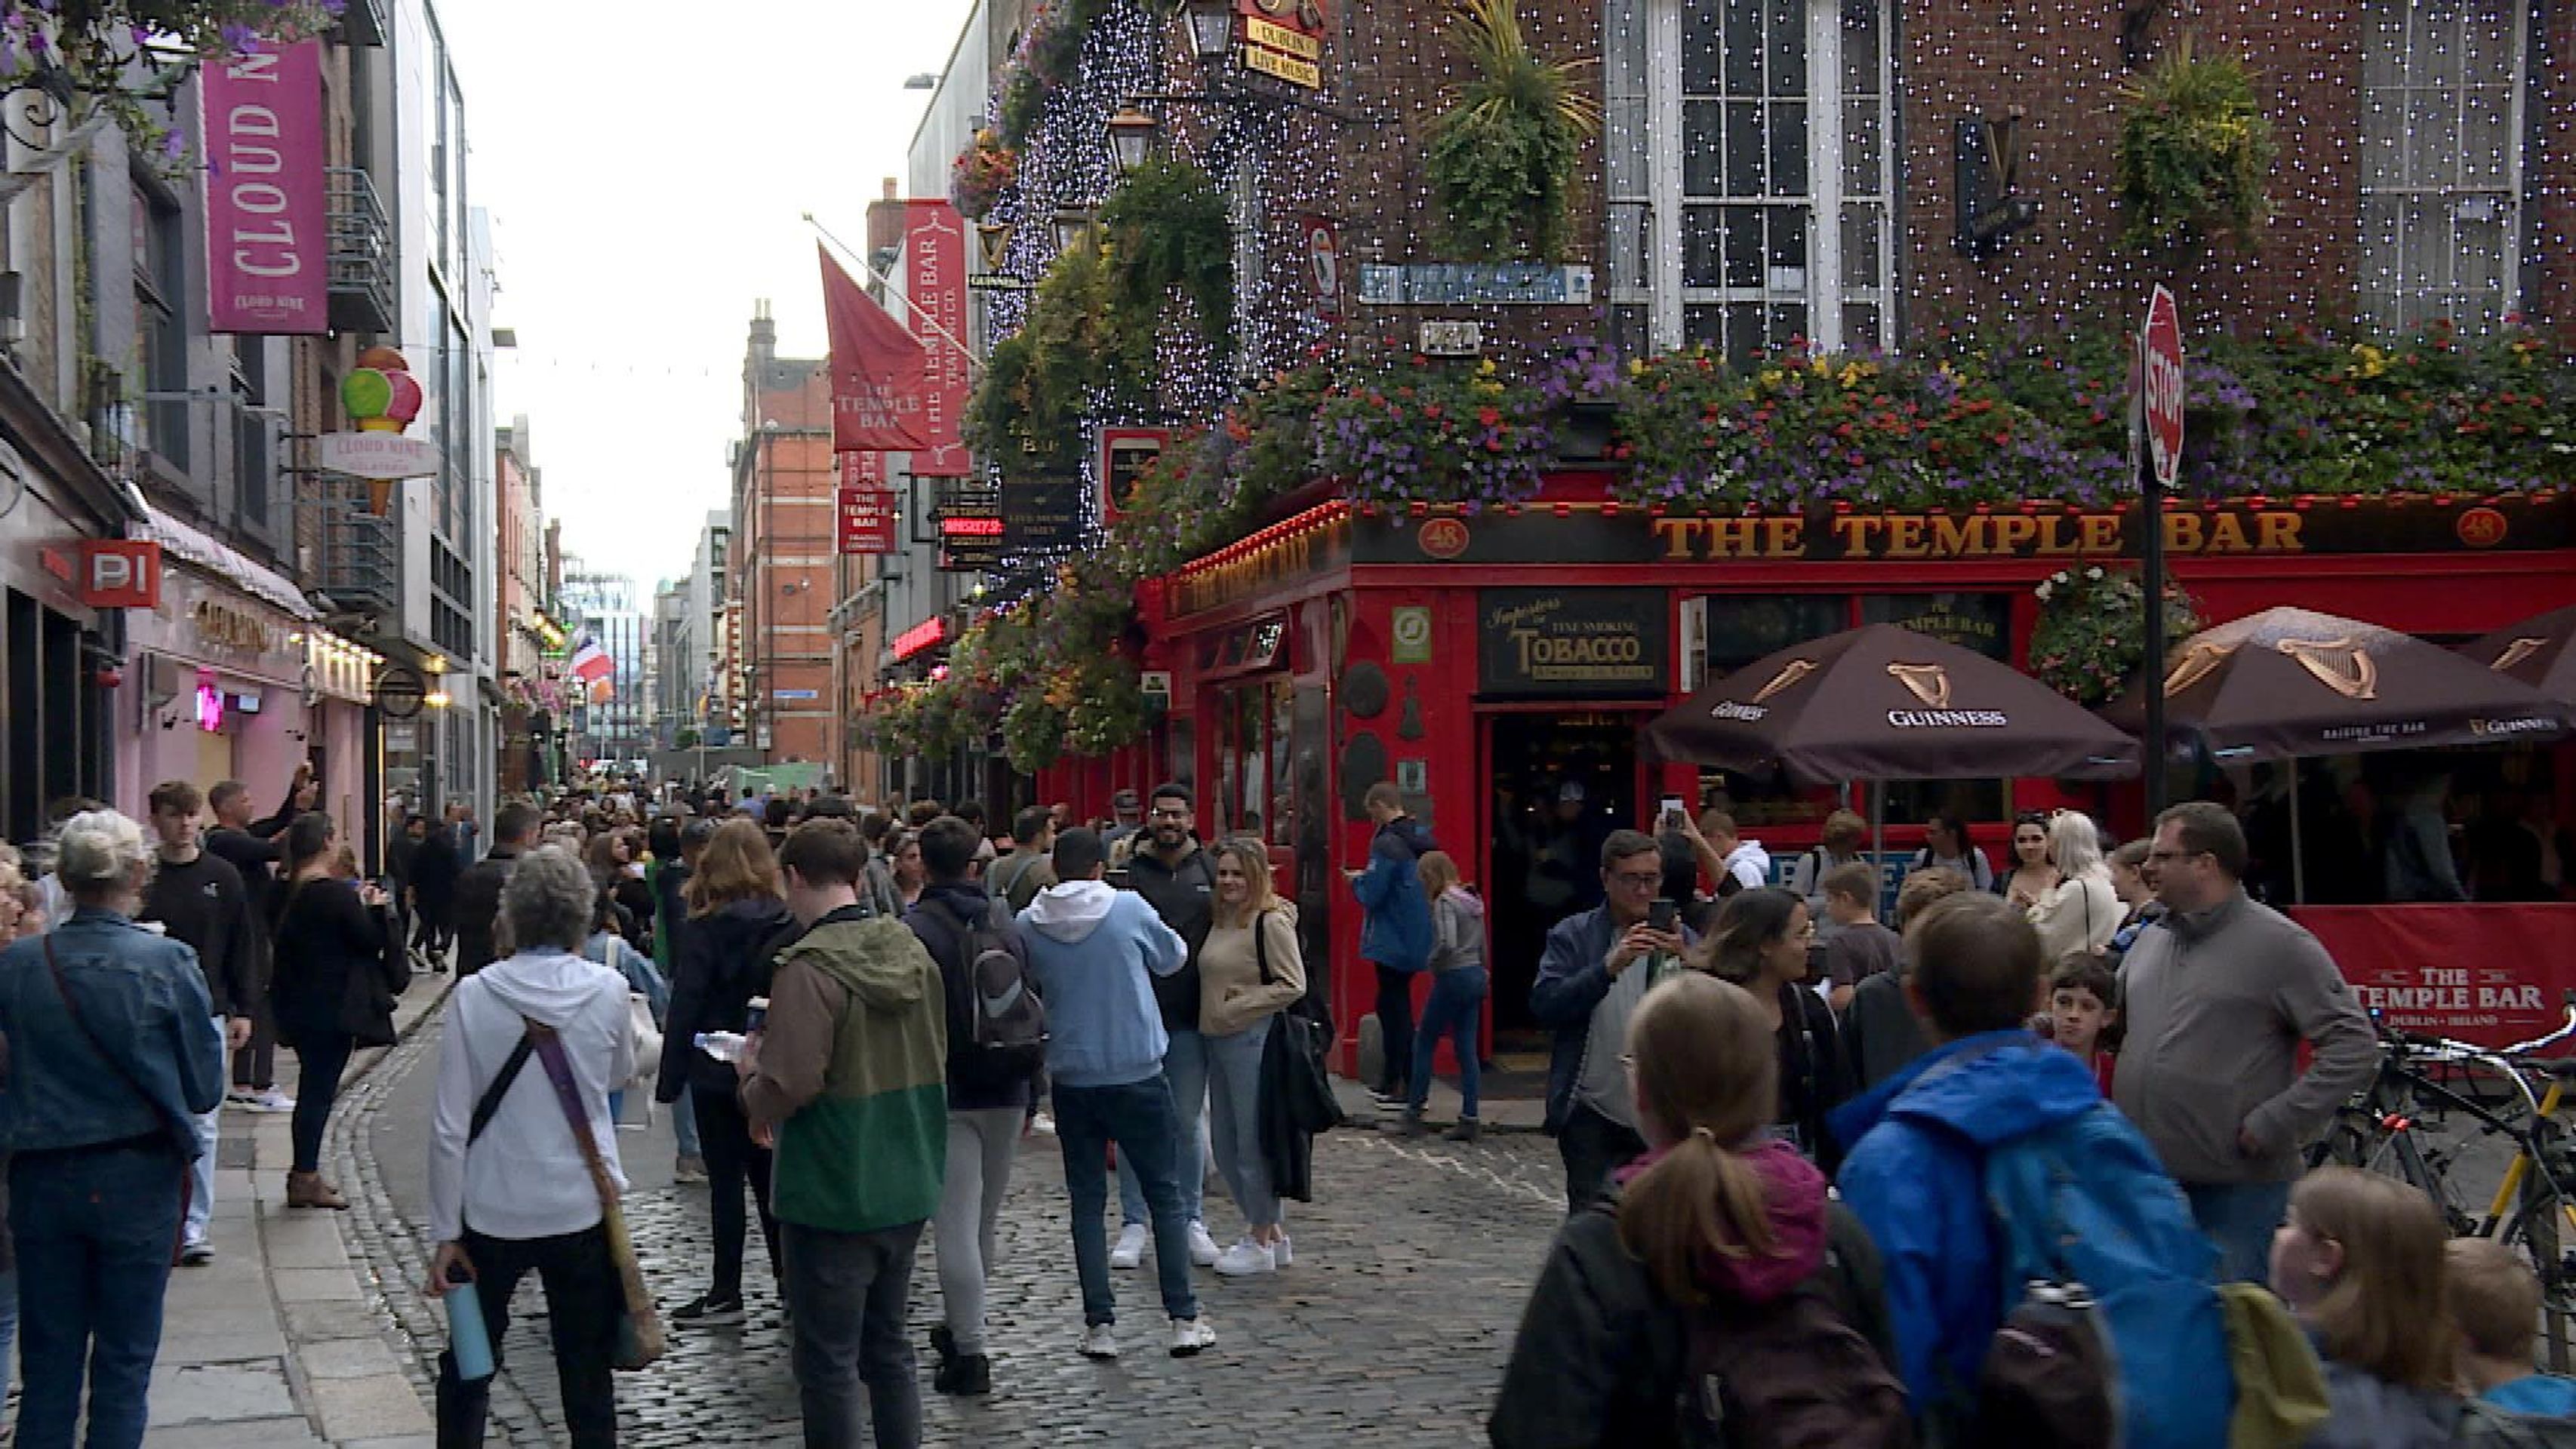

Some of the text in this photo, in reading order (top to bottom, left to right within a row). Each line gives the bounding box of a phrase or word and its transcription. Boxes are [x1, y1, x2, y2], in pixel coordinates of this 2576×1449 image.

[1261, 25, 1305, 53] DUBLIN
[1254, 50, 1315, 82] LIVE MUSIC
[229, 103, 301, 278] CLOUD
[919, 238, 937, 286] BAR
[2150, 346, 2181, 425] STOP
[836, 395, 920, 415] TEMPLE
[336, 438, 384, 454] CLOUD
[854, 494, 878, 503] THE
[844, 504, 890, 516] TEMPLE
[852, 517, 878, 528] BAR
[1426, 525, 1458, 549] 48
[1656, 512, 2304, 558] THE TEMPLE BAR
[92, 553, 146, 592] PI
[1507, 629, 1641, 675] TOBACCO
[1888, 709, 2008, 727] GUINNESS
[2376, 724, 2398, 735] THE
[2402, 721, 2426, 734] BAR
[2487, 718, 2559, 734] GUINNESS
[2419, 966, 2470, 986] THE
[2345, 983, 2545, 1011] TEMPLE BAR
[2389, 1014, 2498, 1026] DUBLIN IRELAND
